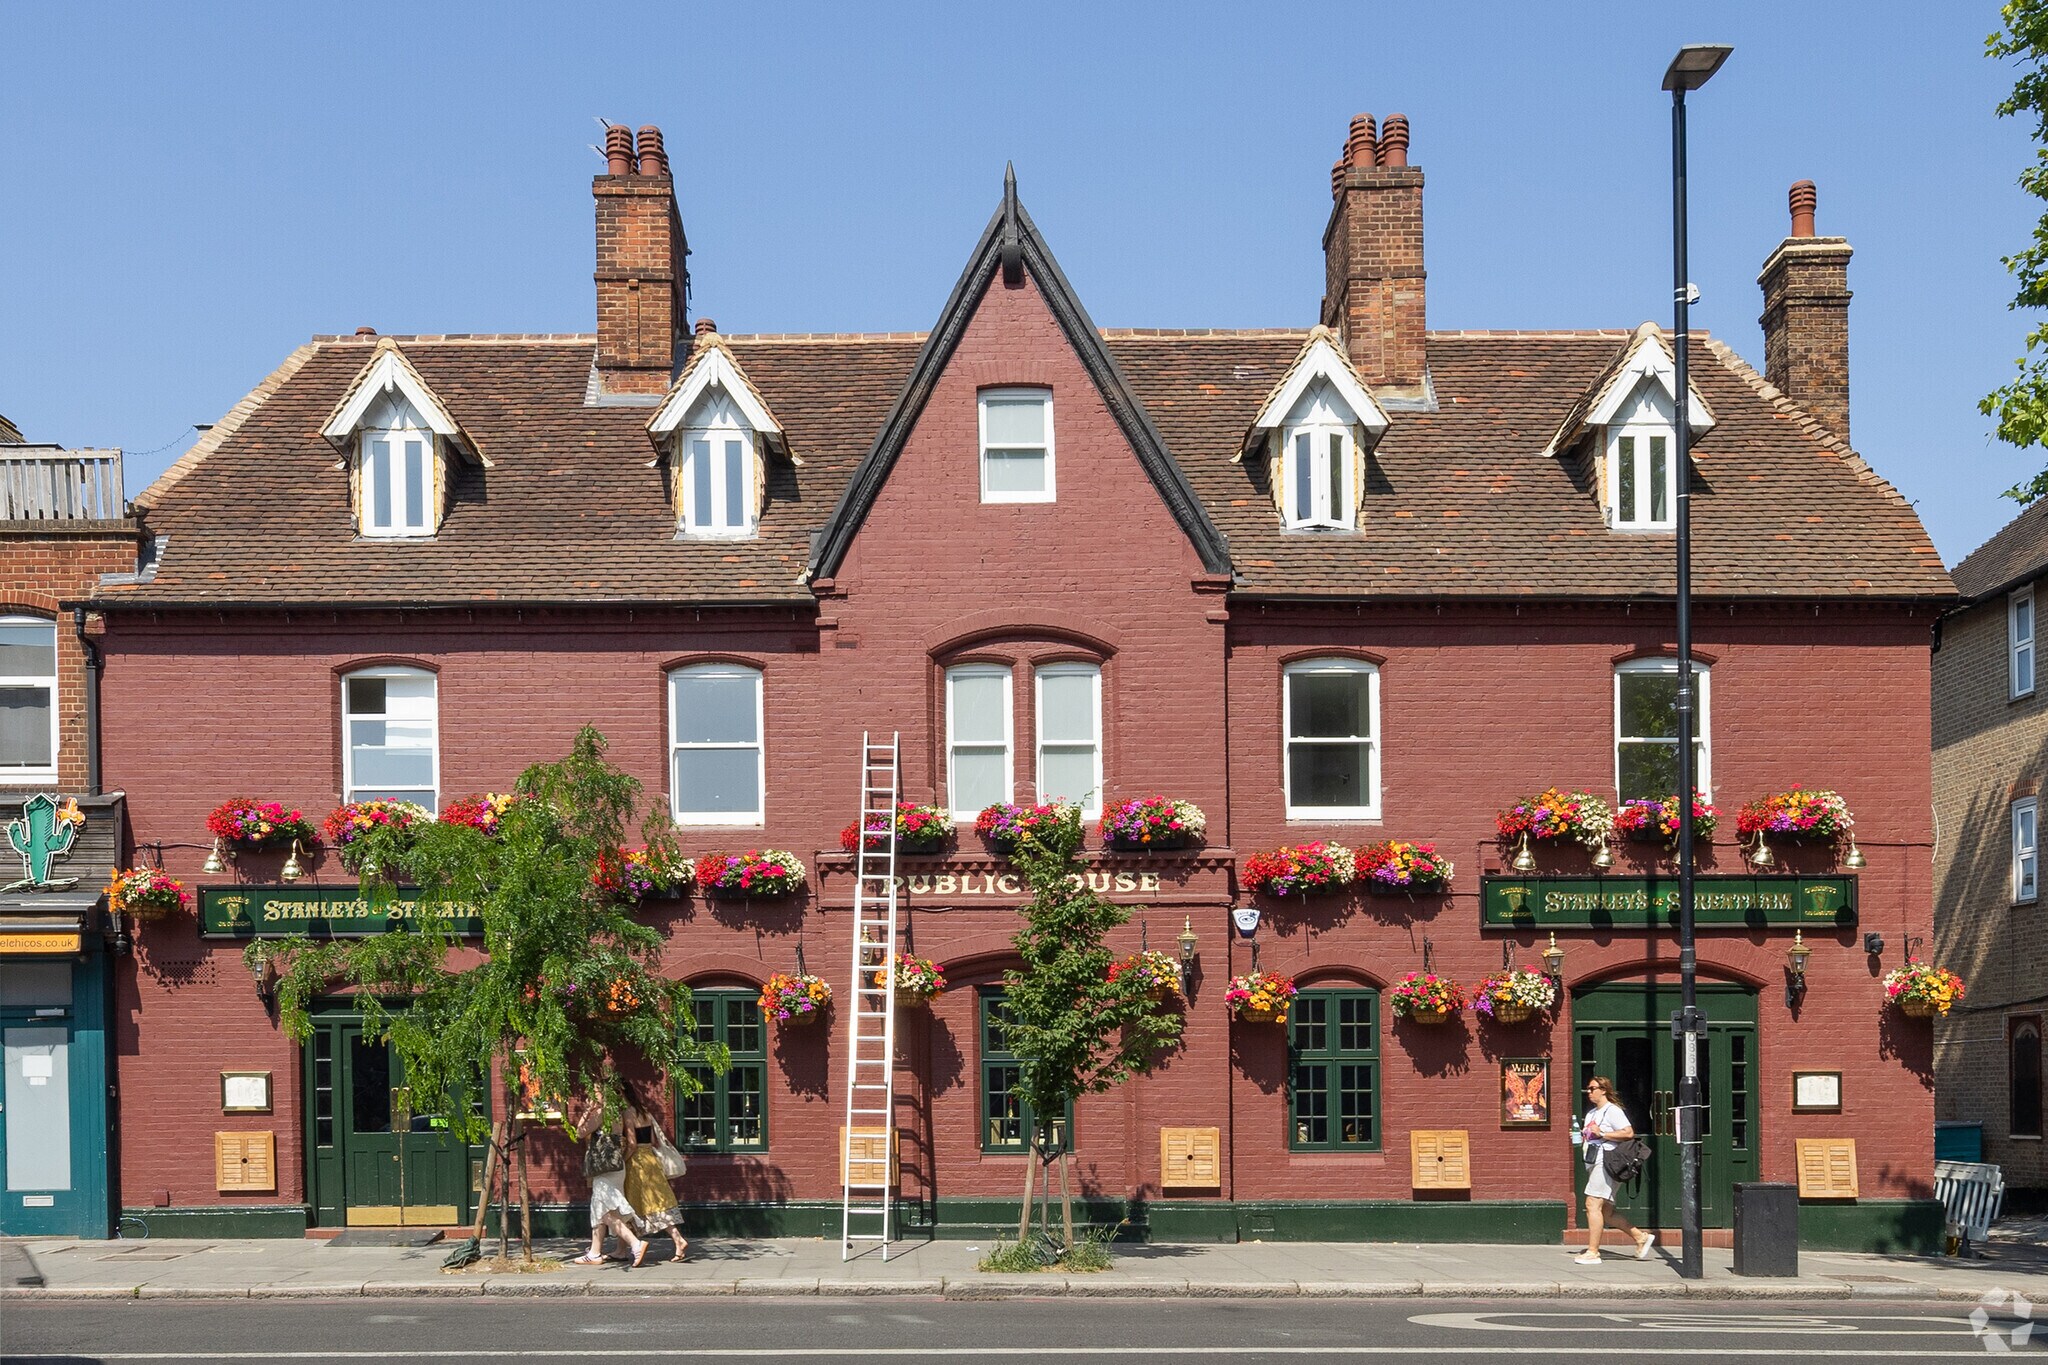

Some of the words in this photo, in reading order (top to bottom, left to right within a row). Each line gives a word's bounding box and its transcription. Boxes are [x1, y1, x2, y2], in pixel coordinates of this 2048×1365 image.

[882, 874, 1021, 894] PUBLIC
[1032, 872, 1160, 893] OUSE
[264, 898, 368, 921] STANLEY'S
[1545, 889, 1649, 912] STANLEY'S
[1667, 892, 1792, 912] SREATHAM
